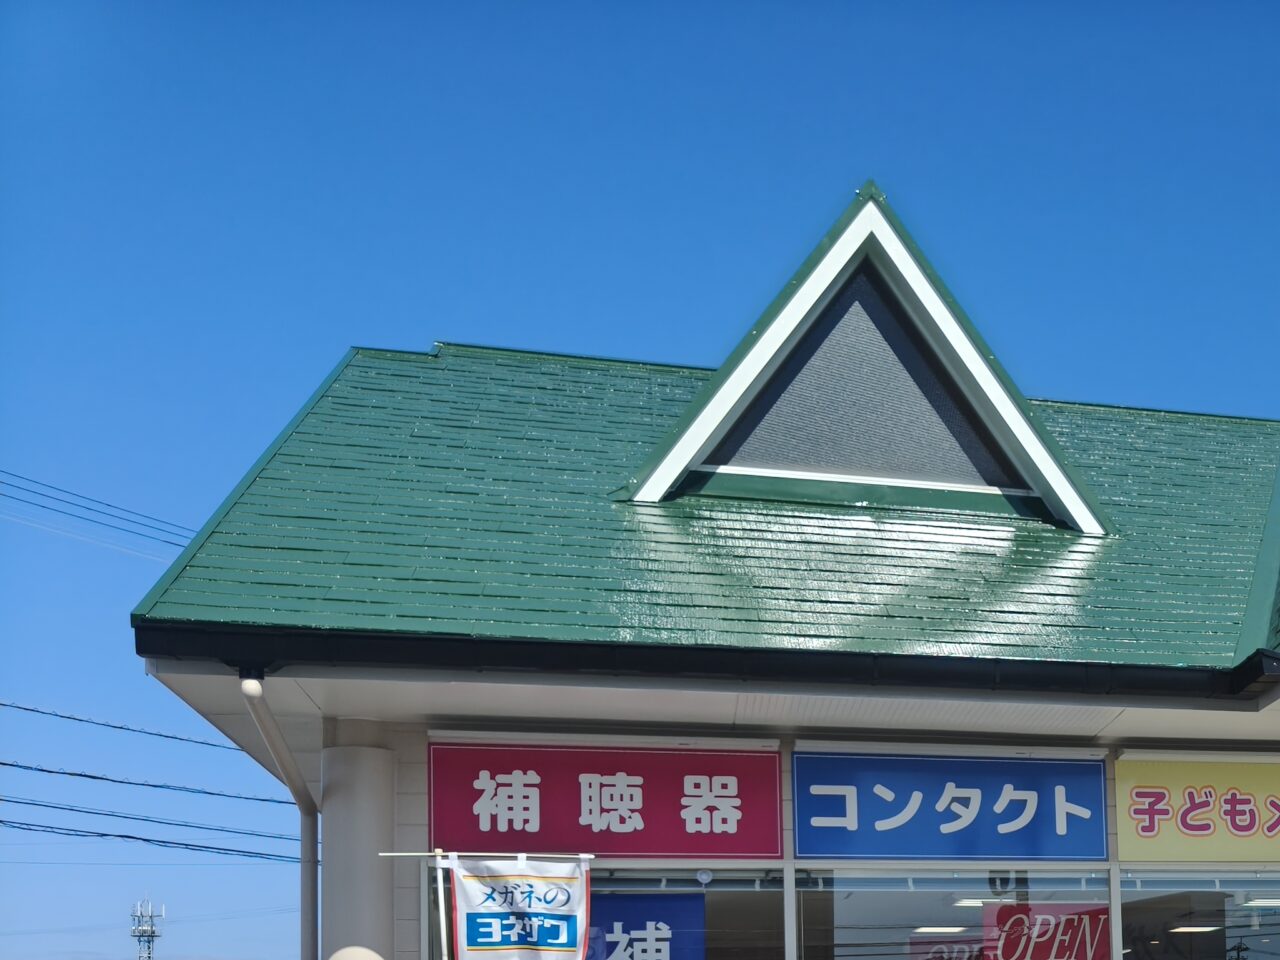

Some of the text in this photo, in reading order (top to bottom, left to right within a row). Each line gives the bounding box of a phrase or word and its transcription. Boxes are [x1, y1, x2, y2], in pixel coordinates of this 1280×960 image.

[473, 770, 743, 834] 補聴器
[809, 782, 1092, 836] コンタクト
[477, 883, 571, 908] メガネの
[476, 915, 569, 944] ヨネザワ
